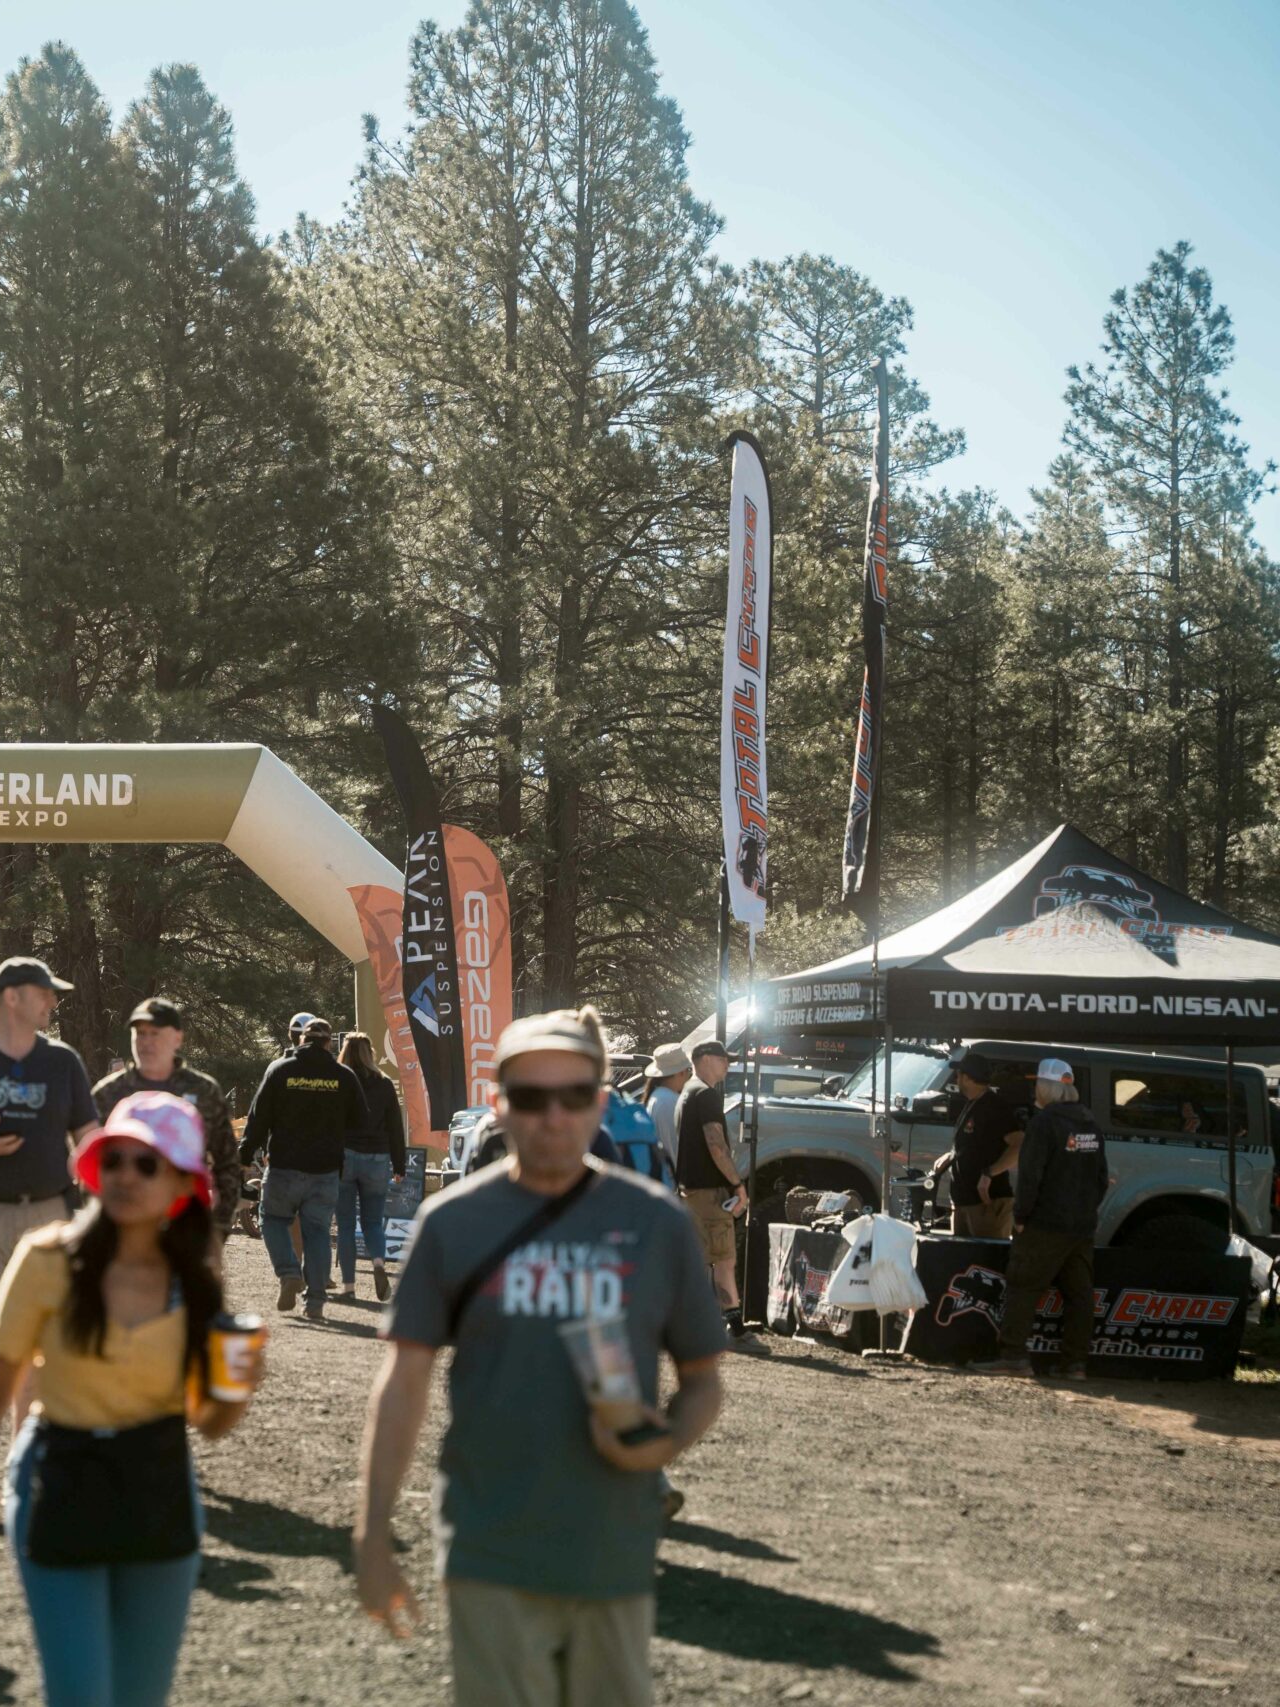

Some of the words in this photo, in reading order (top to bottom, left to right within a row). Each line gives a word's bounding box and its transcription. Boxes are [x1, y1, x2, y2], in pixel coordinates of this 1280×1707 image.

[732, 680, 768, 842] TOTAL
[426, 831, 454, 1035] SUSPENSION
[774, 1008, 806, 1026] SYSTEMS
[806, 1007, 813, 1025] &
[814, 1004, 866, 1024] ACCESSORIES
[792, 985, 812, 1003] ROAD
[813, 982, 862, 1002] SUSPENSION
[503, 1264, 622, 1318] RAID
[1106, 1289, 1239, 1326] CHAOS
